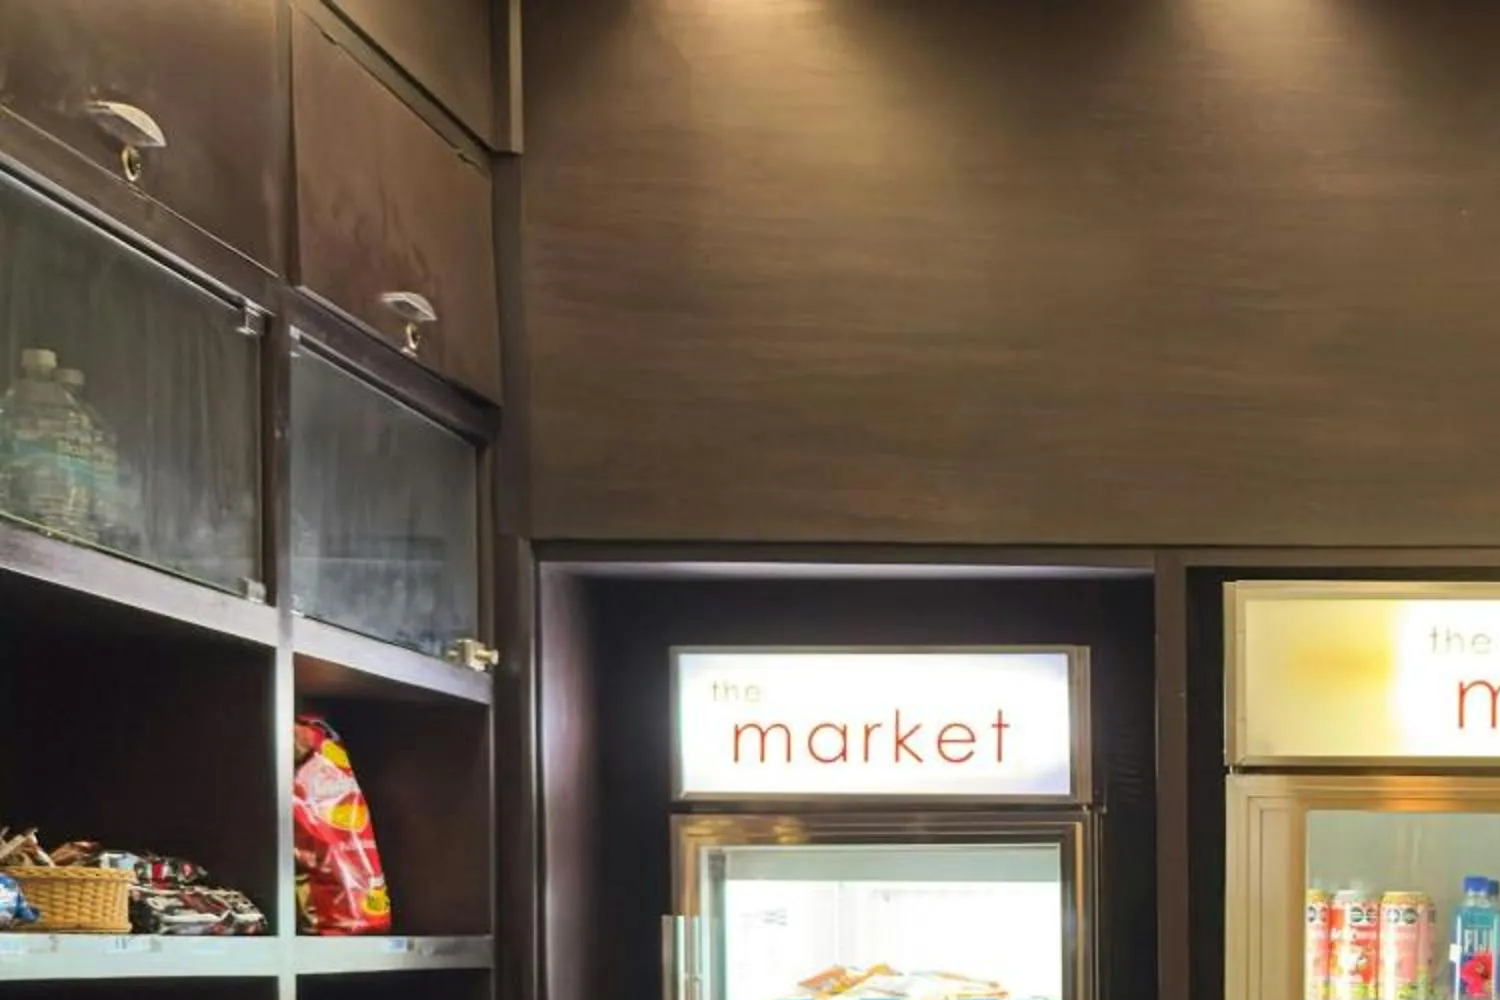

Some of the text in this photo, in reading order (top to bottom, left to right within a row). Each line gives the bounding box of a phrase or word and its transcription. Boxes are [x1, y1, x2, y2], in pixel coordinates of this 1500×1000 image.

[1429, 625, 1493, 655] the
[712, 679, 762, 703] the
[732, 709, 1011, 764] market
